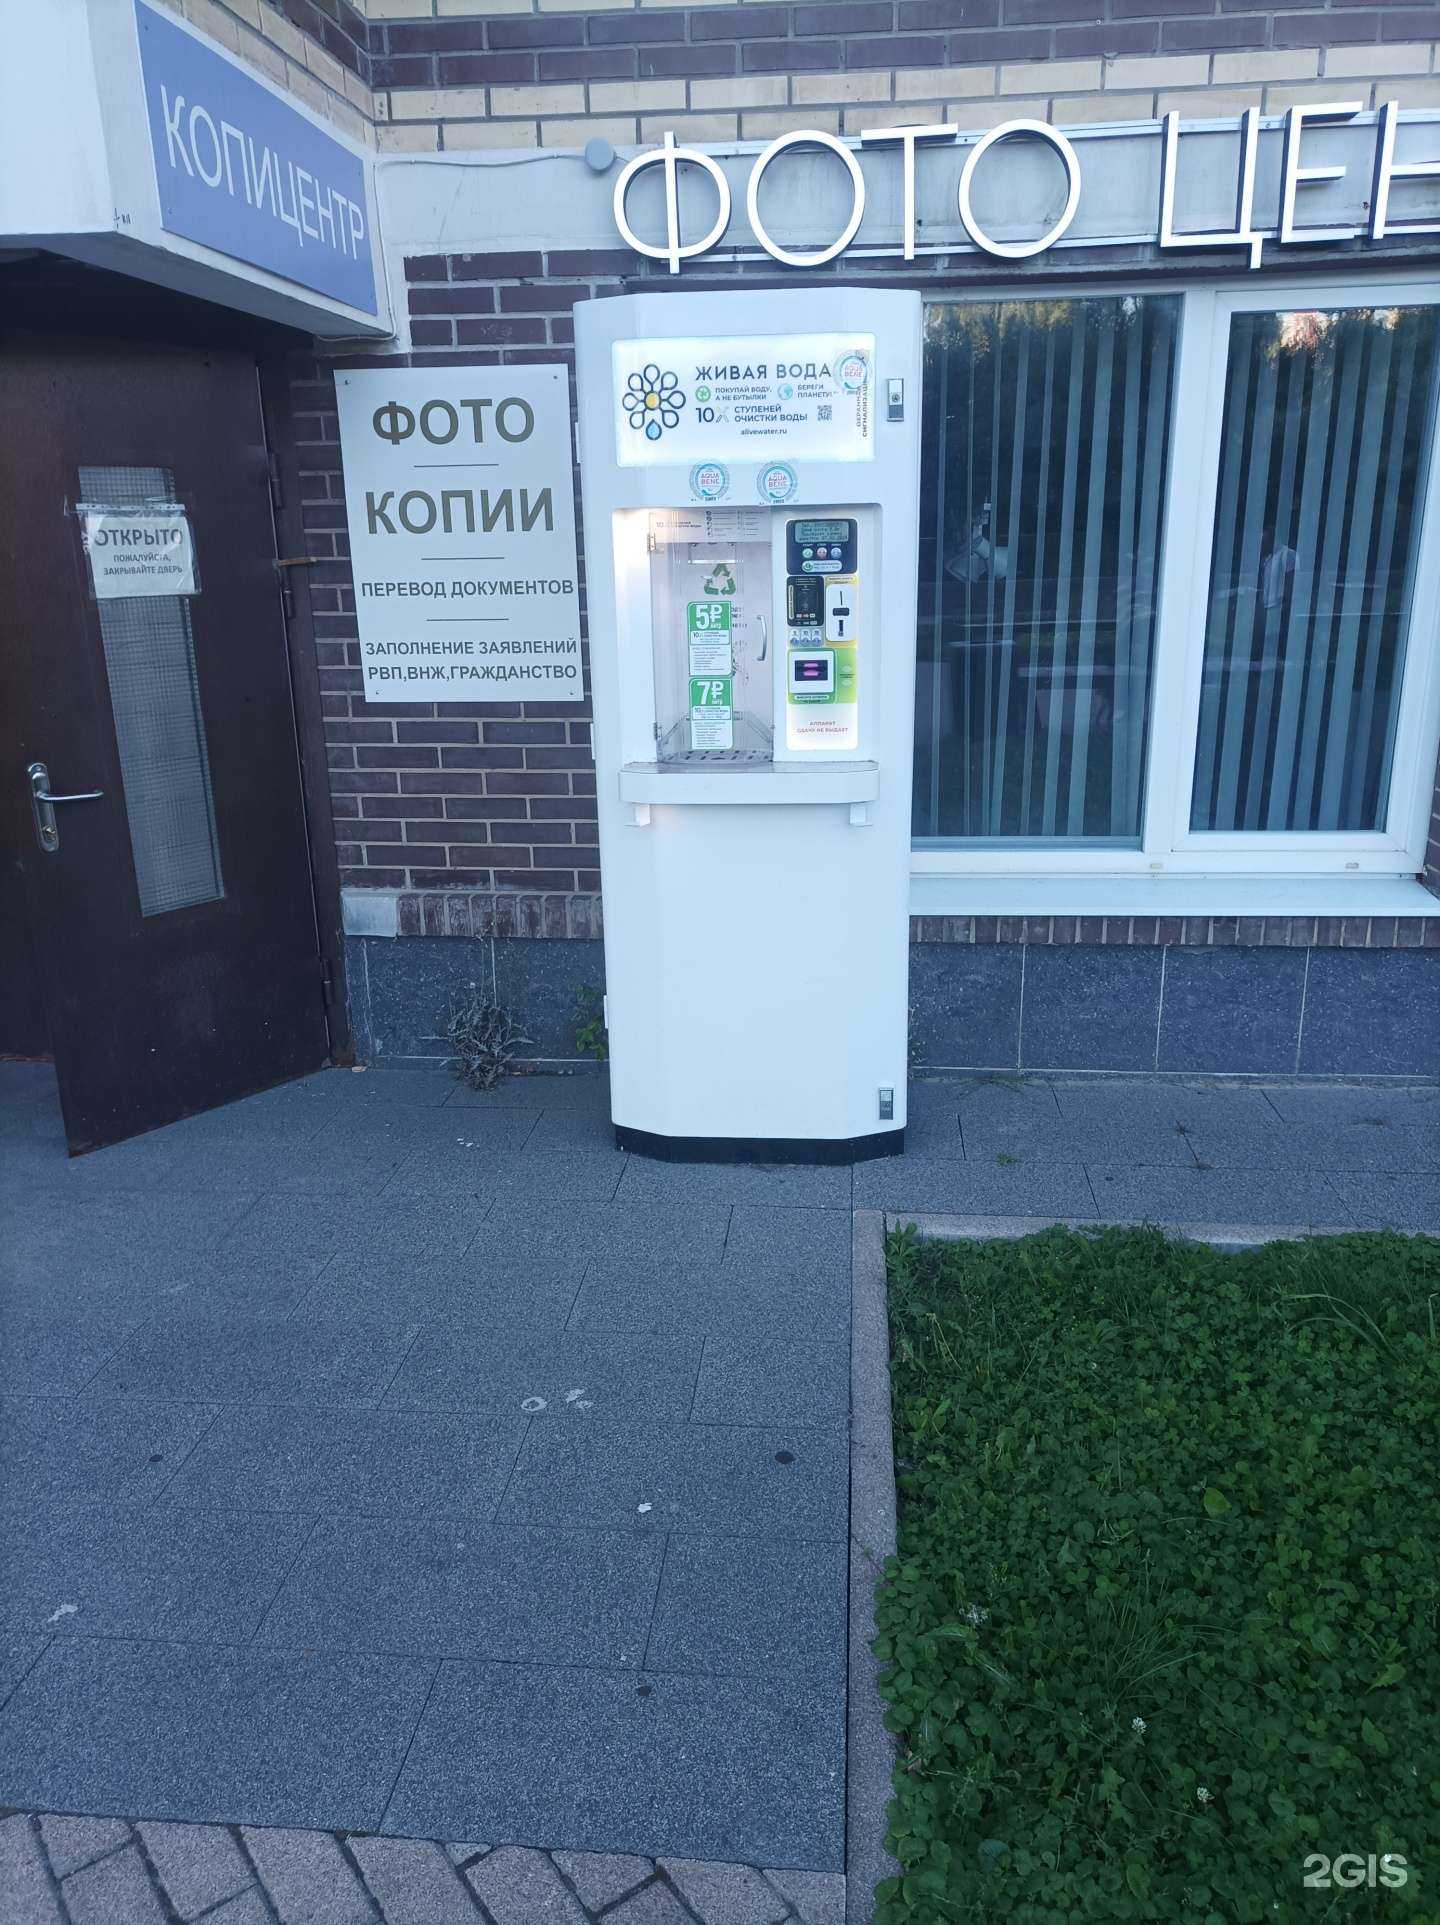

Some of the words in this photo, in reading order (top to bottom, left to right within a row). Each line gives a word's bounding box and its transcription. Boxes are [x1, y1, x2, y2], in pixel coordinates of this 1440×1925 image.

[160, 84, 365, 261] КОПИЦЕНТР
[613, 118, 1082, 275] ФОТО
[695, 364, 768, 381] ЖИВАЯ
[776, 362, 832, 380] ВОДА
[715, 385, 750, 394] ПОКУПАЙ
[695, 407, 715, 423] 10
[734, 403, 782, 414] СТУПЕНЕЙ
[372, 397, 535, 445] ФОТО
[734, 414, 777, 423] ОЧИСТКИ
[780, 413, 808, 422] ВОДЫ!
[740, 427, 788, 435] alivewater.ru
[365, 487, 554, 535] КОПИИ
[94, 528, 184, 546] ОТКРЫТО
[103, 565, 155, 576] ЗАКРЫВАЙТЕ
[157, 565, 183, 575] ДВЕРЬ
[361, 581, 447, 599] ПЕРЕВОД
[451, 579, 574, 598] ДОКУМЕНТОВ
[365, 641, 474, 656] ЗАПОЛНЕНИЕ
[479, 637, 577, 655] ЗАЯВЛЕНИЙ
[368, 665, 577, 683] РВП,ВНЖ,ГРАЖДАНСТВО
